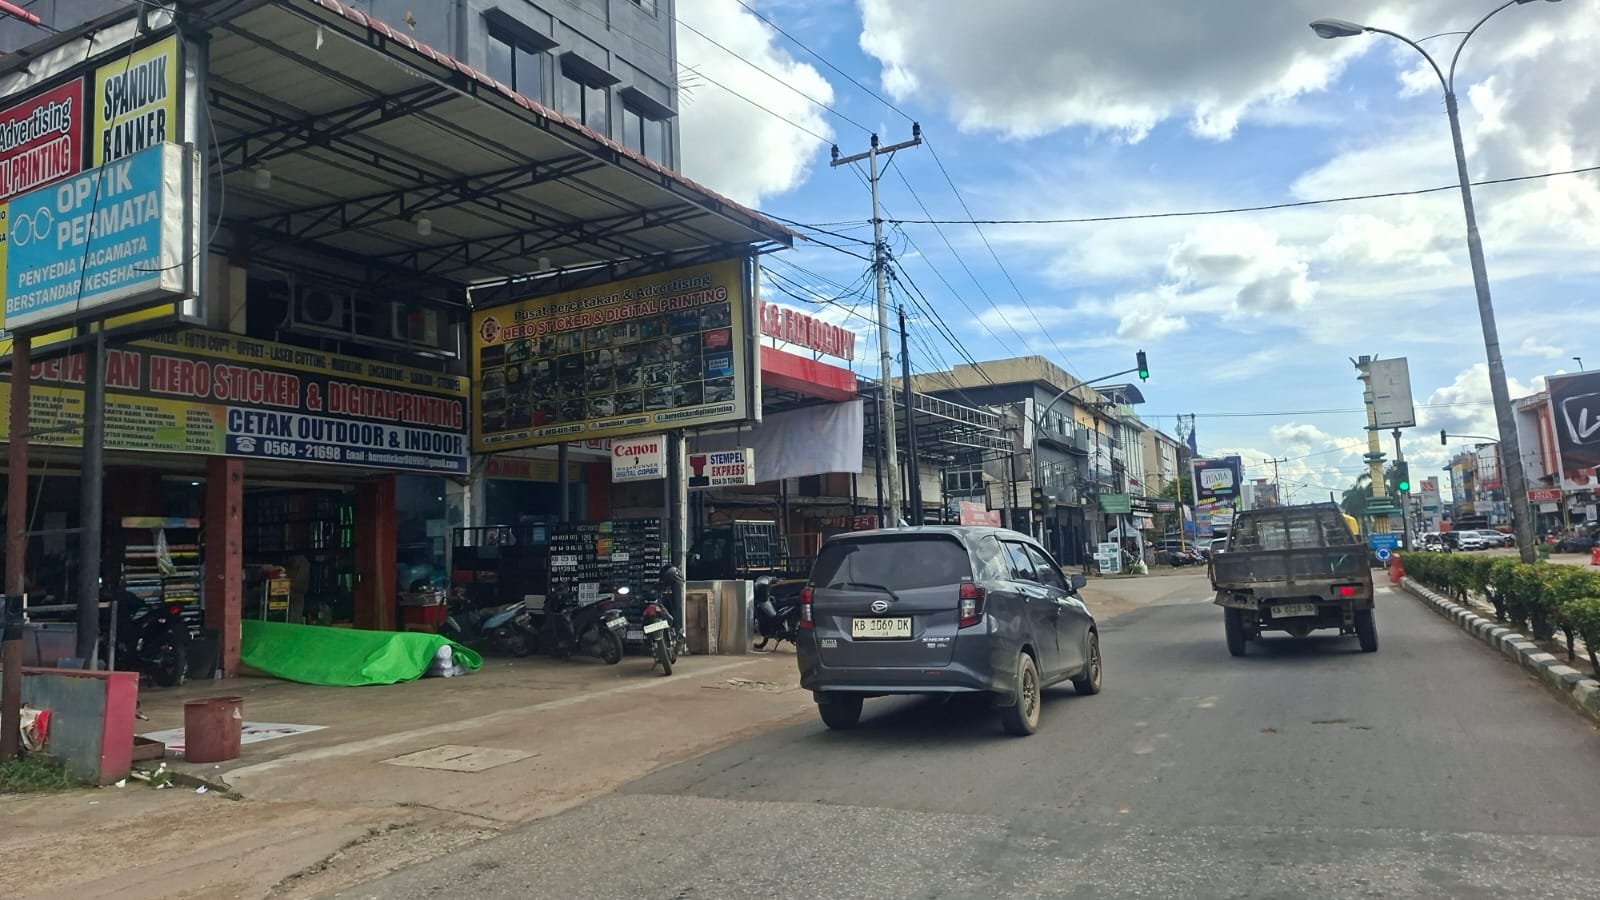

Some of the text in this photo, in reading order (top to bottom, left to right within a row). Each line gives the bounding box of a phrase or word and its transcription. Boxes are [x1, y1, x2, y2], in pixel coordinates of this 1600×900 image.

[103, 53, 168, 122] SPANDUK
[0, 97, 72, 152] Advertising
[103, 108, 166, 163] BANNER
[11, 135, 71, 194] PRINTING
[56, 160, 133, 214] OPTIK
[57, 190, 160, 251] PERMATA
[6, 256, 161, 314] BERSTANDAR KESEHATAN
[18, 236, 148, 289] PENYEDIA KACAMATA
[502, 286, 728, 341] HERO STICKER & DIGITAL PRINTING
[513, 272, 712, 323] Pusat Percetakan & Advertising
[767, 304, 781, 337] &
[781, 308, 856, 360] FOTOCOPY
[150, 355, 210, 398] HERO
[213, 363, 300, 409] STICKER
[306, 382, 323, 412] &
[228, 408, 463, 455] CETAK OUTDOOR & INDOOR
[263, 440, 296, 457] 0564
[305, 444, 341, 461] 21698
[346, 449, 365, 461] Email
[614, 444, 657, 456] Canon
[710, 452, 744, 464] STEMPEL
[854, 620, 866, 631] KB
[897, 619, 909, 631] DK
